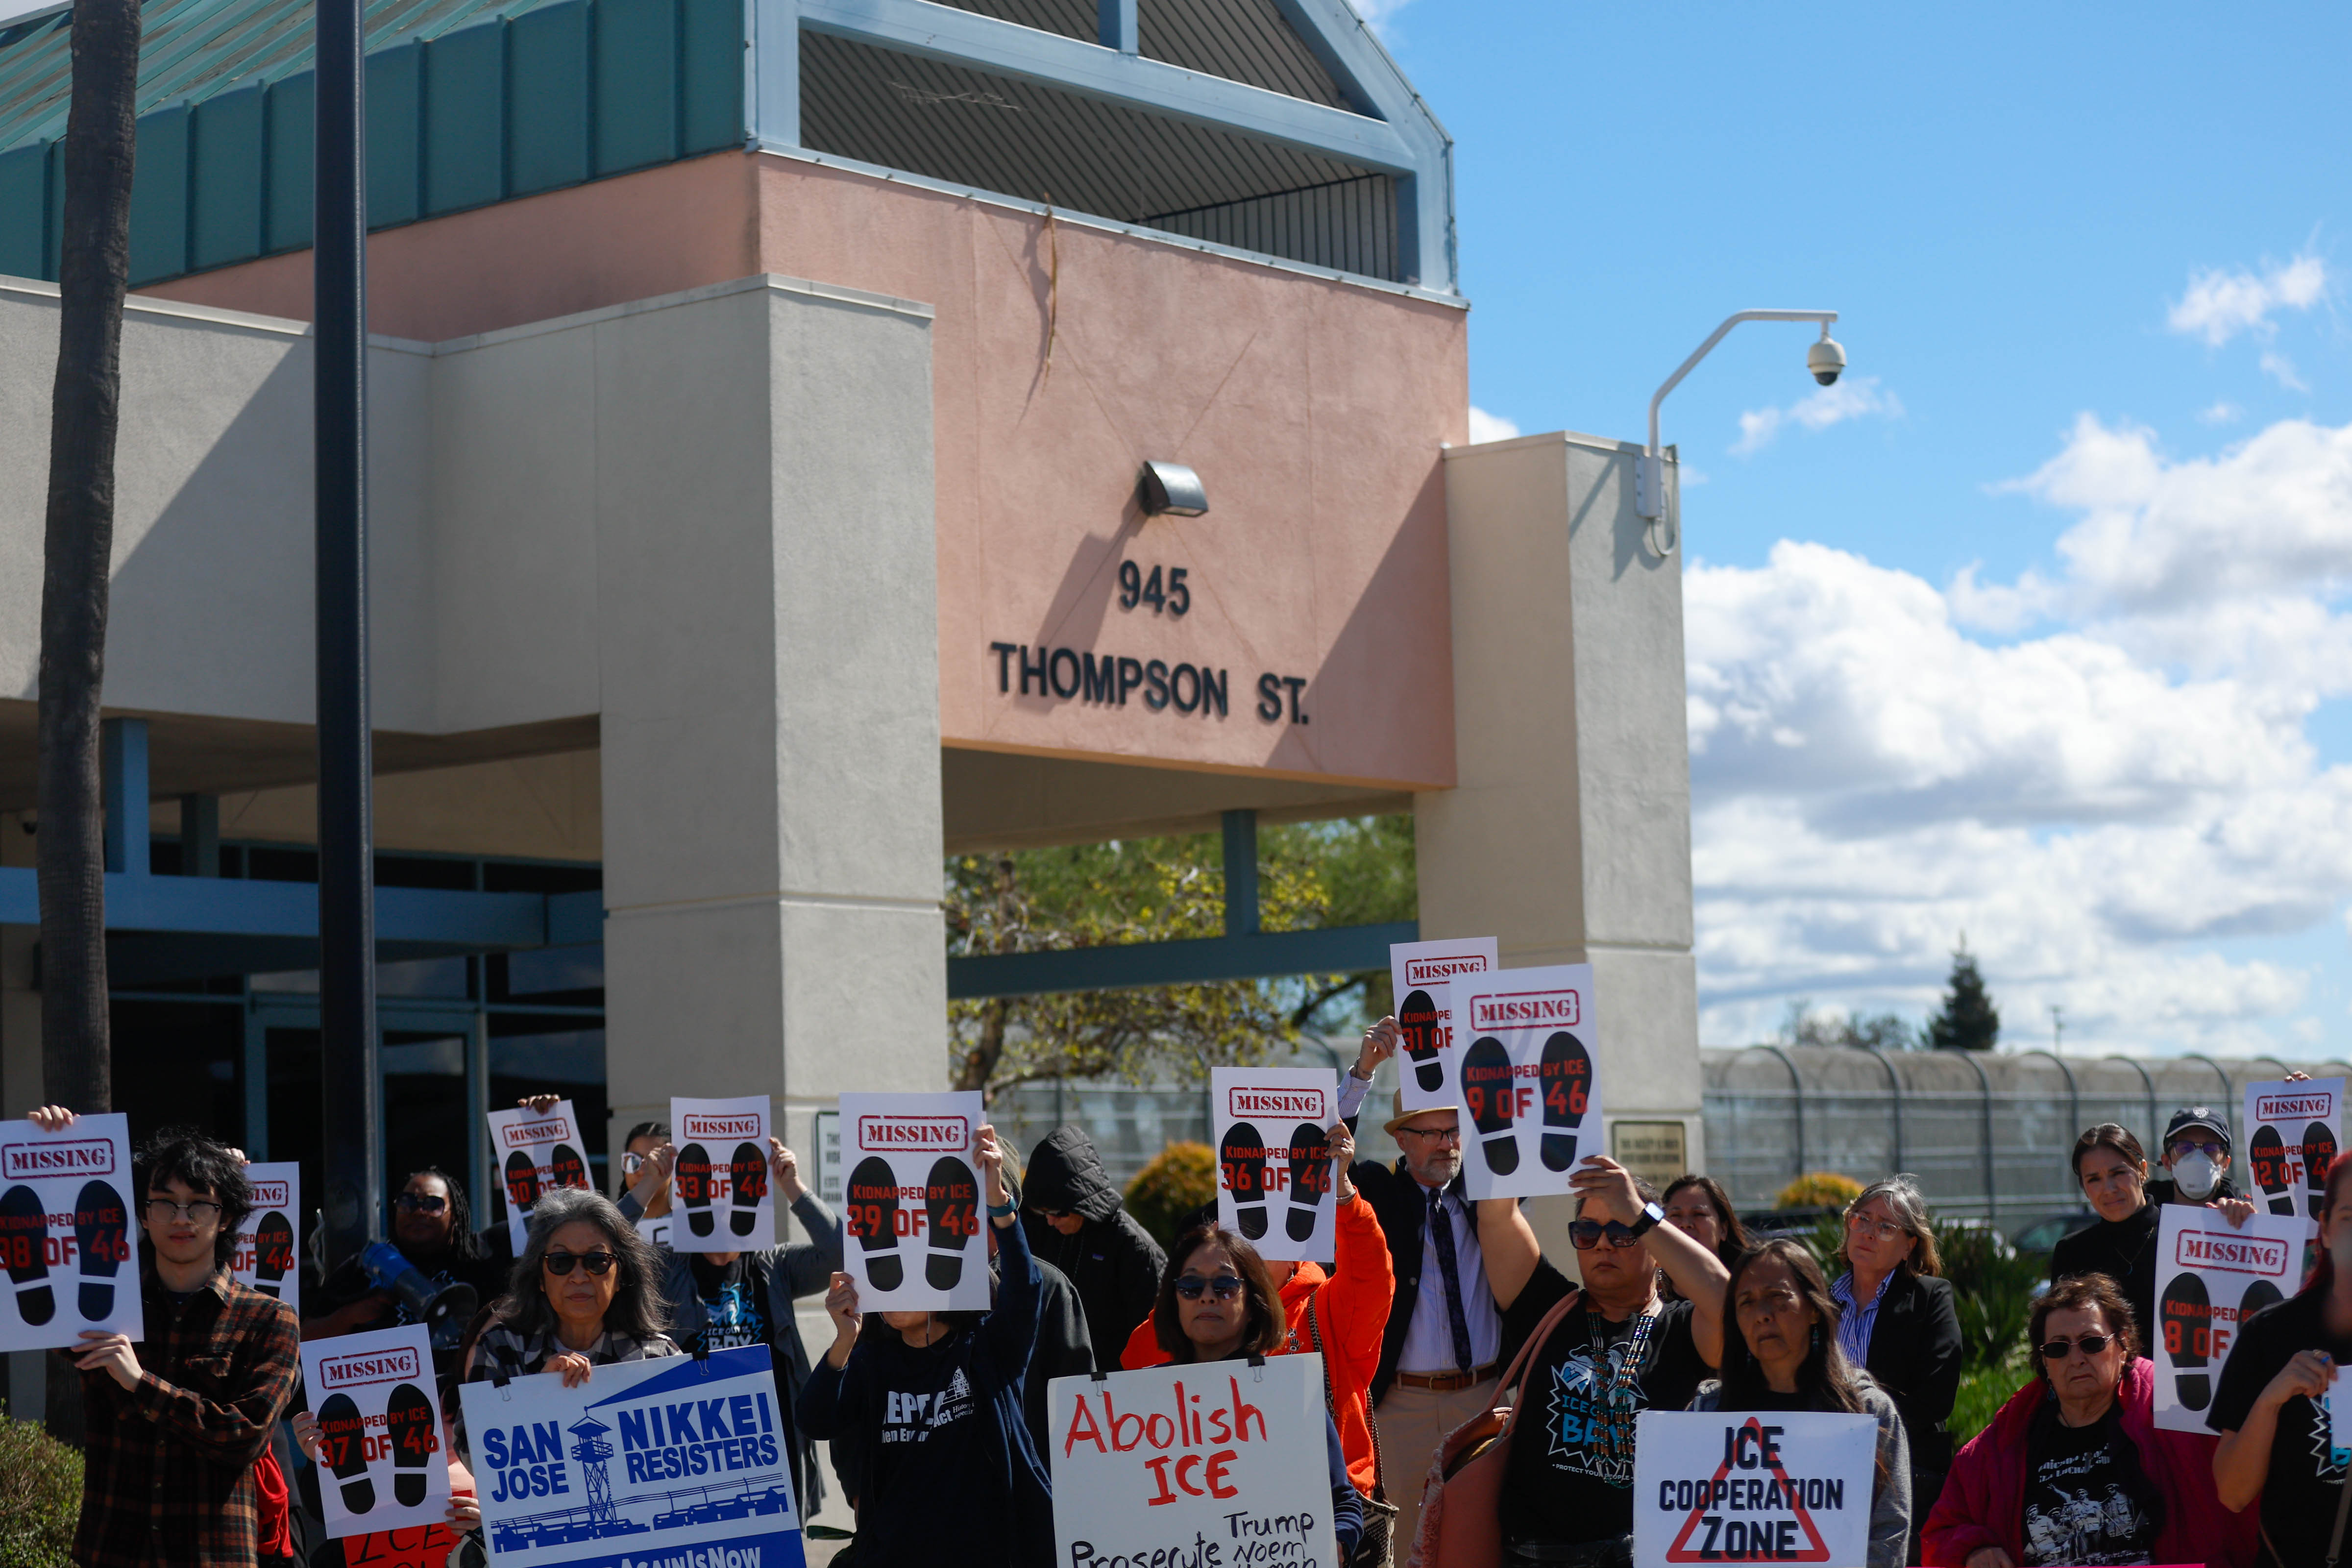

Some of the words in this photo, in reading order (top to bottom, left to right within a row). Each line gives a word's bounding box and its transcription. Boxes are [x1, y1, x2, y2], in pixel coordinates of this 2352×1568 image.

[1119, 560, 1190, 615] 945
[991, 642, 1228, 716] THOMPSON
[1258, 673, 1309, 724] ST.
[1412, 962, 1479, 979] MISSING
[1404, 1009, 1452, 1023] KIDNAPPE
[1479, 1000, 1571, 1021] MISSING
[1402, 1027, 1423, 1051] 31
[1431, 1027, 1453, 1048] OF
[1467, 1064, 1540, 1081] KIDNAPPED
[1544, 1062, 1560, 1077] BY
[1564, 1059, 1586, 1076] ICE
[1236, 1096, 1317, 1111] MISSING
[1467, 1086, 1485, 1120] 9
[1496, 1087, 1534, 1119] OF
[1546, 1080, 1588, 1115] 46
[2262, 1099, 2326, 1114] MISSING
[509, 1124, 563, 1142] MISSING
[690, 1120, 755, 1134] MISSING
[867, 1125, 959, 1142] MISSING
[11, 1149, 106, 1170] MISSING
[1225, 1146, 1289, 1159] KIDNAPPED
[1292, 1148, 1306, 1159] BY
[1310, 1147, 1328, 1160] ICE
[2254, 1145, 2303, 1157] KIDNAPPED
[2304, 1144, 2317, 1154] BY
[2318, 1142, 2333, 1153] ICE
[508, 1165, 553, 1180] KIDNAPPED
[554, 1162, 565, 1172] BY
[565, 1159, 580, 1170] ICE
[679, 1162, 730, 1173] KIDNAPPED
[733, 1162, 745, 1173] BY
[747, 1161, 762, 1172] ICE
[1221, 1163, 1251, 1191] 36
[1260, 1167, 1291, 1192] OF
[1300, 1164, 1332, 1194] 46
[2251, 1161, 2274, 1186] 12
[2279, 1162, 2303, 1184] OF
[507, 1181, 531, 1205] 30
[675, 1176, 700, 1199] 33
[706, 1179, 733, 1200] OF
[739, 1175, 768, 1198] 46
[853, 1184, 926, 1200] KIDNAPPED
[929, 1186, 946, 1200] BY
[950, 1184, 972, 1199] ICE
[0, 1213, 74, 1230] KIDNAPPED
[77, 1211, 95, 1225] BY
[99, 1208, 121, 1224] ICE
[847, 1204, 882, 1237] 29
[892, 1209, 929, 1238] OF
[939, 1204, 980, 1237] 46
[42, 1236, 78, 1267] OF
[90, 1228, 132, 1263] 46
[258, 1233, 271, 1244] BY
[273, 1231, 289, 1243] ICE
[232, 1250, 258, 1272] OF
[266, 1246, 295, 1271] 46
[2184, 1240, 2278, 1266] MISSING
[2166, 1300, 2238, 1322] KIDNAPPED
[2164, 1320, 2182, 1354] 8
[2193, 1327, 2231, 1360] OF
[328, 1356, 412, 1381] MISSING
[1562, 1394, 1590, 1413] ICE
[321, 1414, 387, 1434] KIDNAPPED
[390, 1411, 405, 1424] BY
[408, 1406, 428, 1421] ICE
[617, 1392, 773, 1452] NIKKEI
[1064, 1375, 1267, 1458] Abolish
[318, 1436, 350, 1469] 37
[360, 1433, 392, 1462] OF
[403, 1424, 440, 1455] 46
[483, 1421, 564, 1470] SAN
[1724, 1426, 1784, 1470] ICE
[625, 1434, 779, 1484] RESISTERS
[1556, 1464, 1584, 1473] PROTECT
[491, 1462, 570, 1502] JOSE
[1145, 1449, 1239, 1506] ICE
[1659, 1479, 1843, 1511] COOPERATION
[1223, 1511, 1314, 1544] Trump
[1699, 1517, 1799, 1560] ZONE
[1233, 1541, 1305, 1563] Noem
